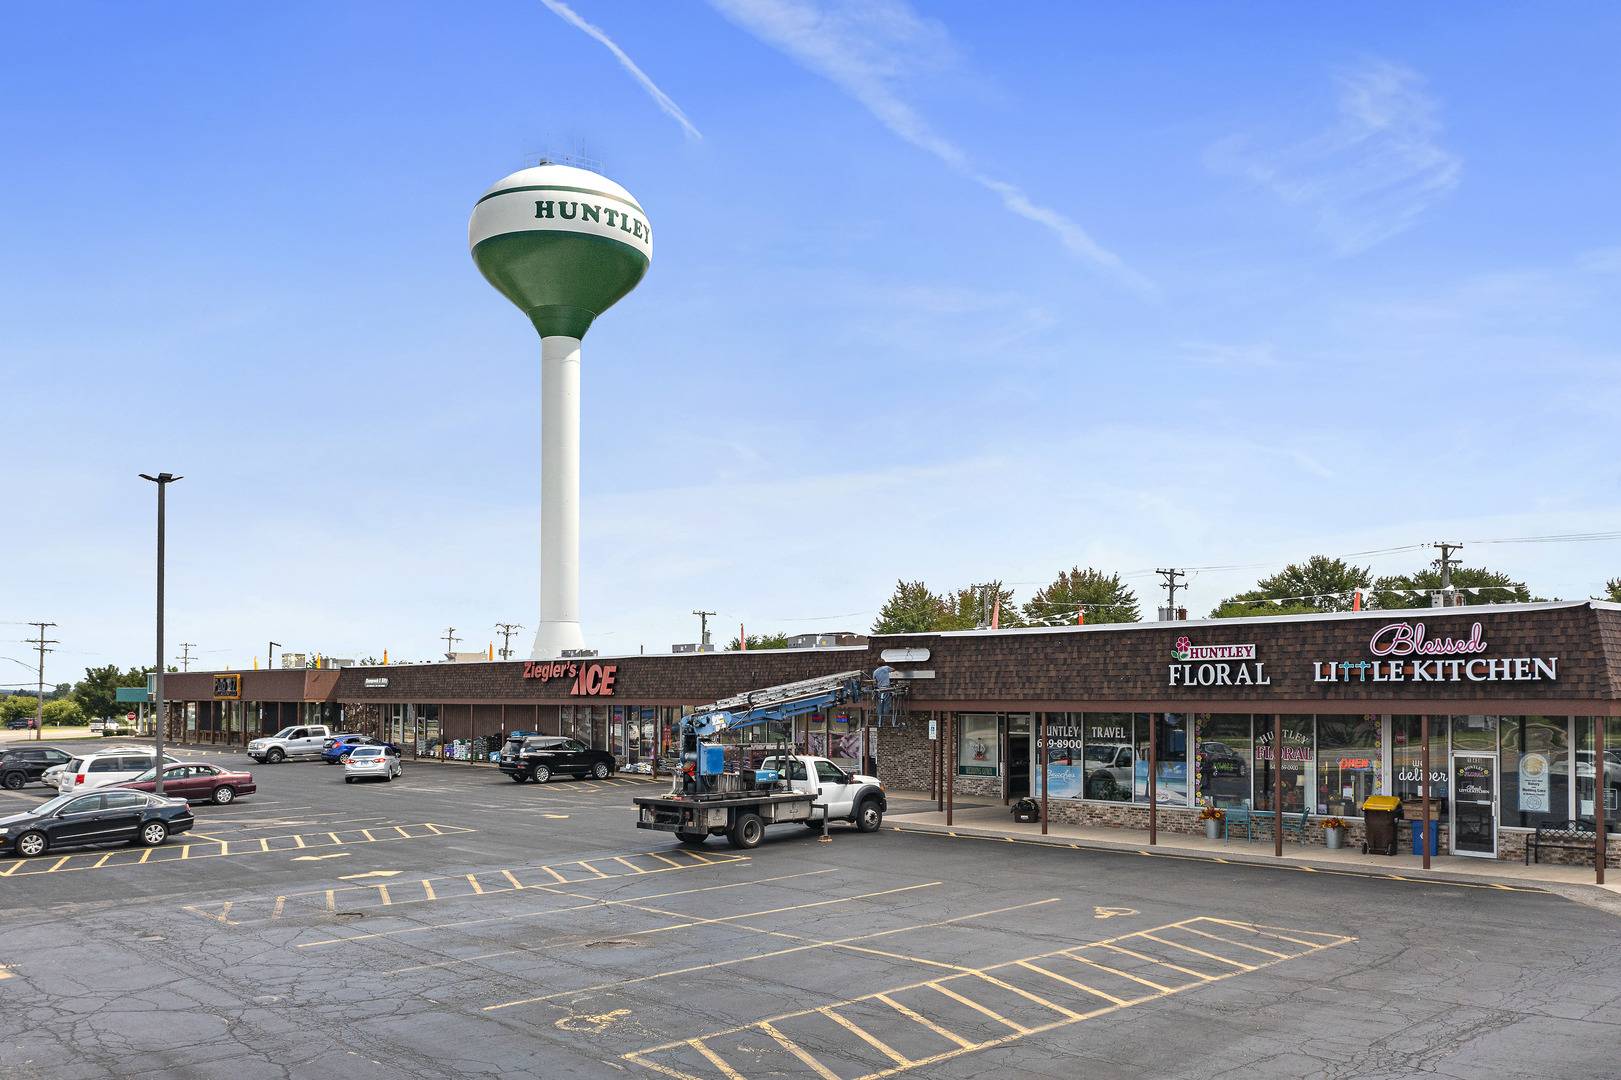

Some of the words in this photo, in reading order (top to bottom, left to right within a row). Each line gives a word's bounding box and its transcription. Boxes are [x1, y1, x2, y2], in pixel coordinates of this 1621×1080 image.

[534, 200, 650, 245] HUNTLEY
[1370, 622, 1487, 656] Blessed
[1189, 646, 1253, 659] HUNTLEY
[523, 660, 577, 683] Ziegler's
[570, 660, 616, 696] ACE
[1168, 662, 1271, 686] FLORAL
[1411, 657, 1558, 681] KITCHEN
[1092, 726, 1126, 739] TRAVEL
[1259, 729, 1310, 745] HUTLEY
[1036, 738, 1082, 749] 69-8900
[1398, 766, 1449, 782] delier
